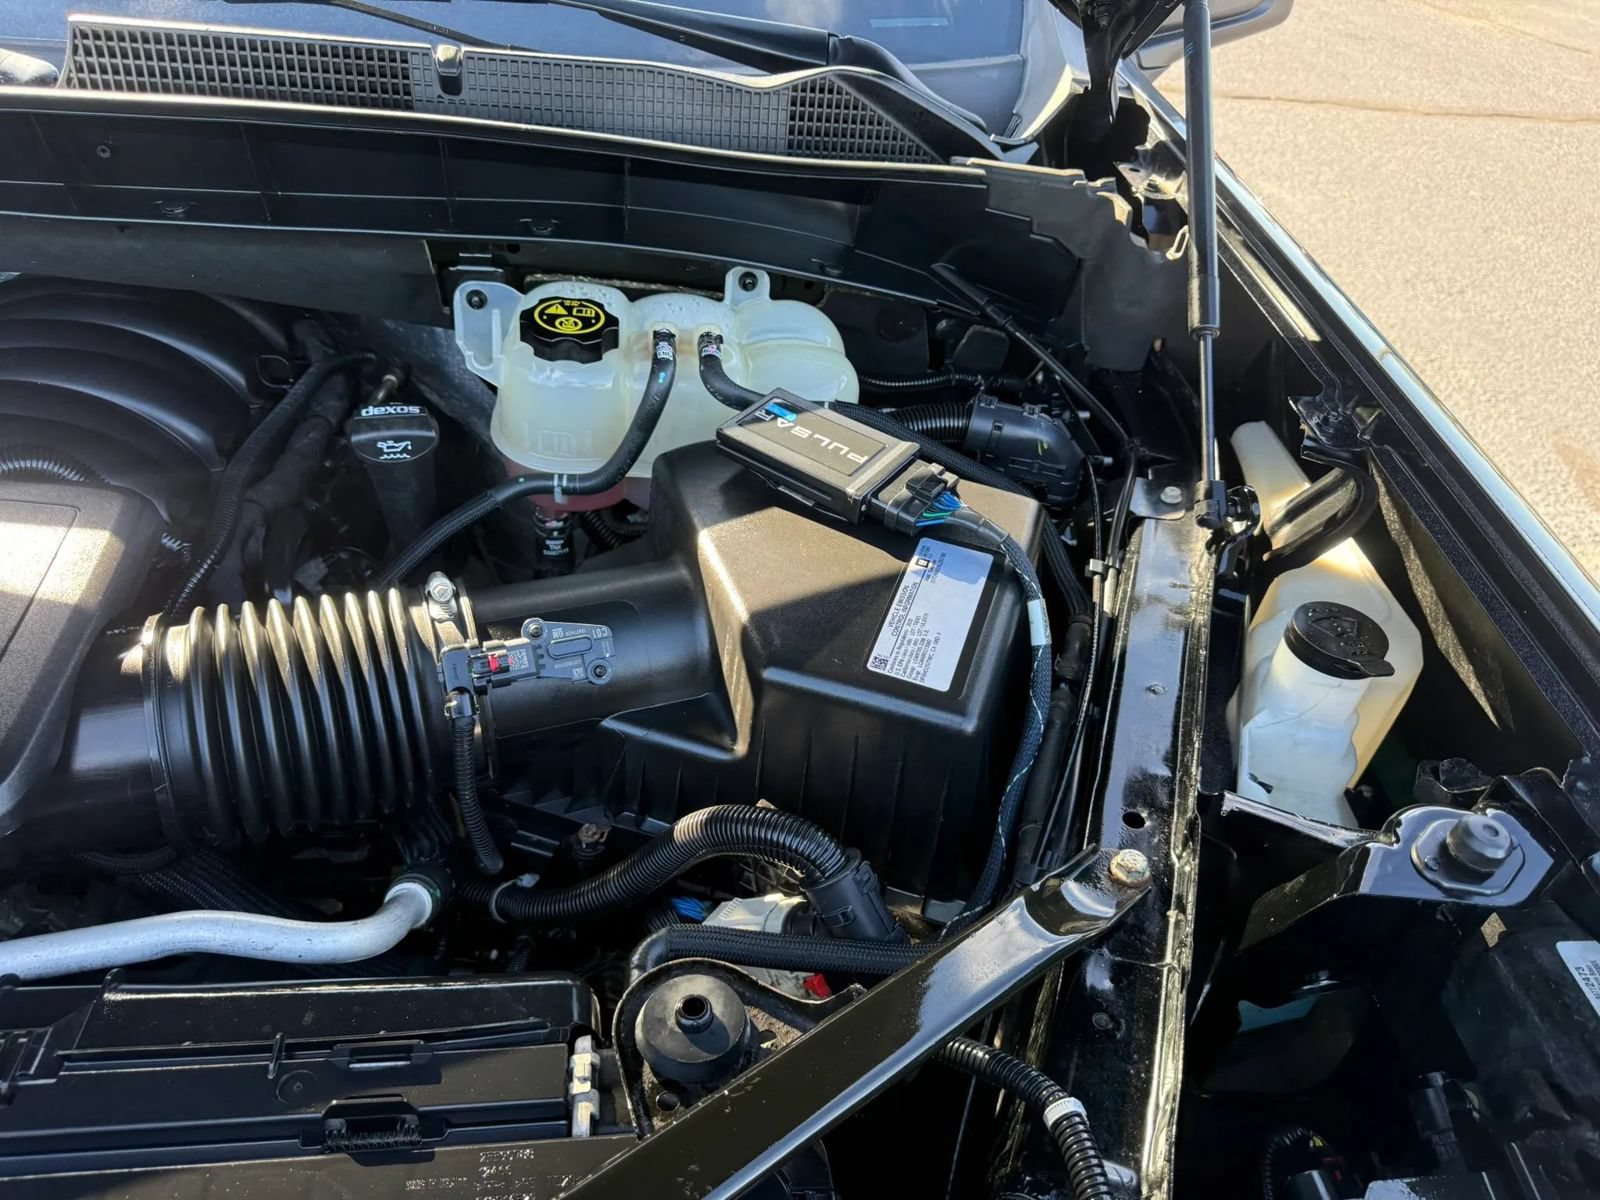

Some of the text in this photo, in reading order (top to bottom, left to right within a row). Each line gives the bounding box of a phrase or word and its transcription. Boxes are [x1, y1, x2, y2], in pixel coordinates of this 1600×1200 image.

[361, 405, 418, 416] dexos
[754, 408, 869, 464] PULSAR
[887, 608, 901, 629] VEHICLE
[891, 582, 919, 637] CONTROL INFORMATION
